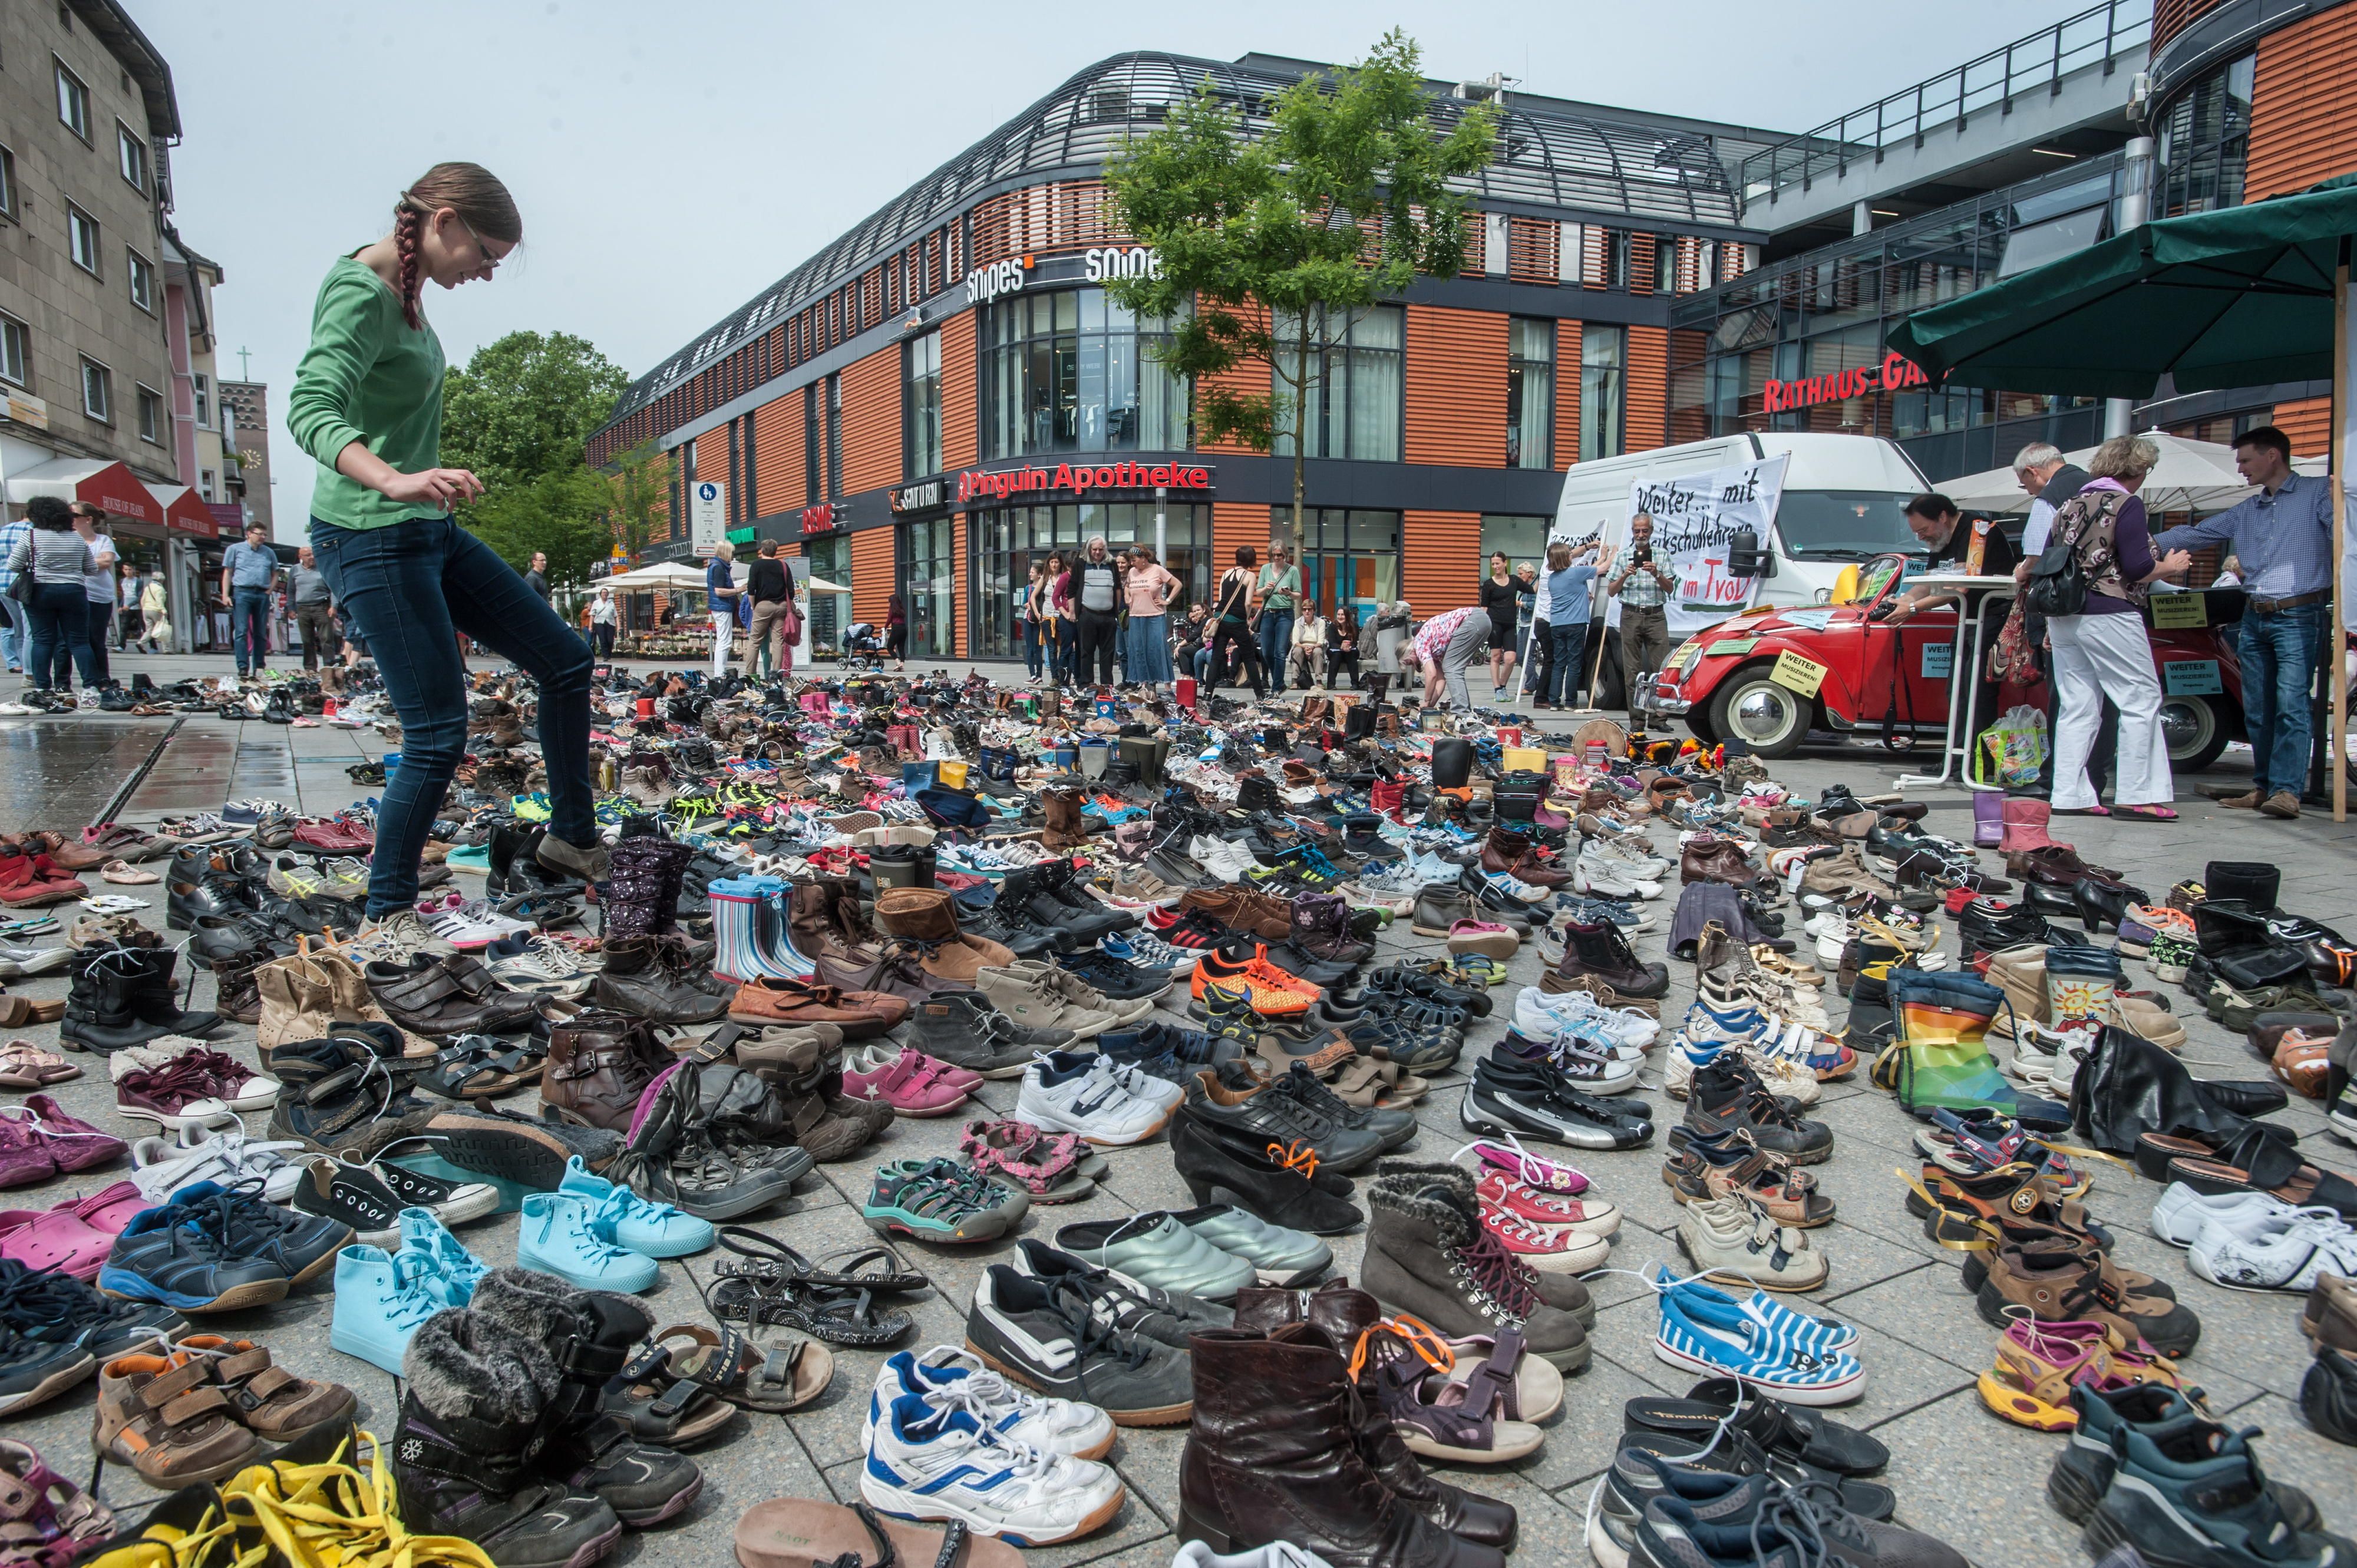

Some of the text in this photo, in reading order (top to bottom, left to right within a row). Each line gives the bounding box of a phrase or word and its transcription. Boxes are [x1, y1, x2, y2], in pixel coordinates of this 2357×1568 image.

[967, 257, 1024, 304] snipes
[1085, 247, 1166, 285] snipe
[1763, 352, 1929, 413] RATHAUS-GA
[970, 460, 1209, 499] Pinguin Apotheke
[1722, 467, 1759, 504] mit
[103, 496, 145, 517] HOUSE OF JEANS
[903, 482, 937, 511] SATURN
[179, 516, 192, 529] HOUSE
[198, 520, 210, 534] JEANS
[803, 503, 833, 534] REWE
[1683, 564, 1698, 598] im
[2155, 596, 2191, 605] WEITER
[1781, 662, 1817, 683] MUSIZIEREN!
[1785, 652, 1817, 672] WEITER
[2168, 663, 2206, 671] WEITER
